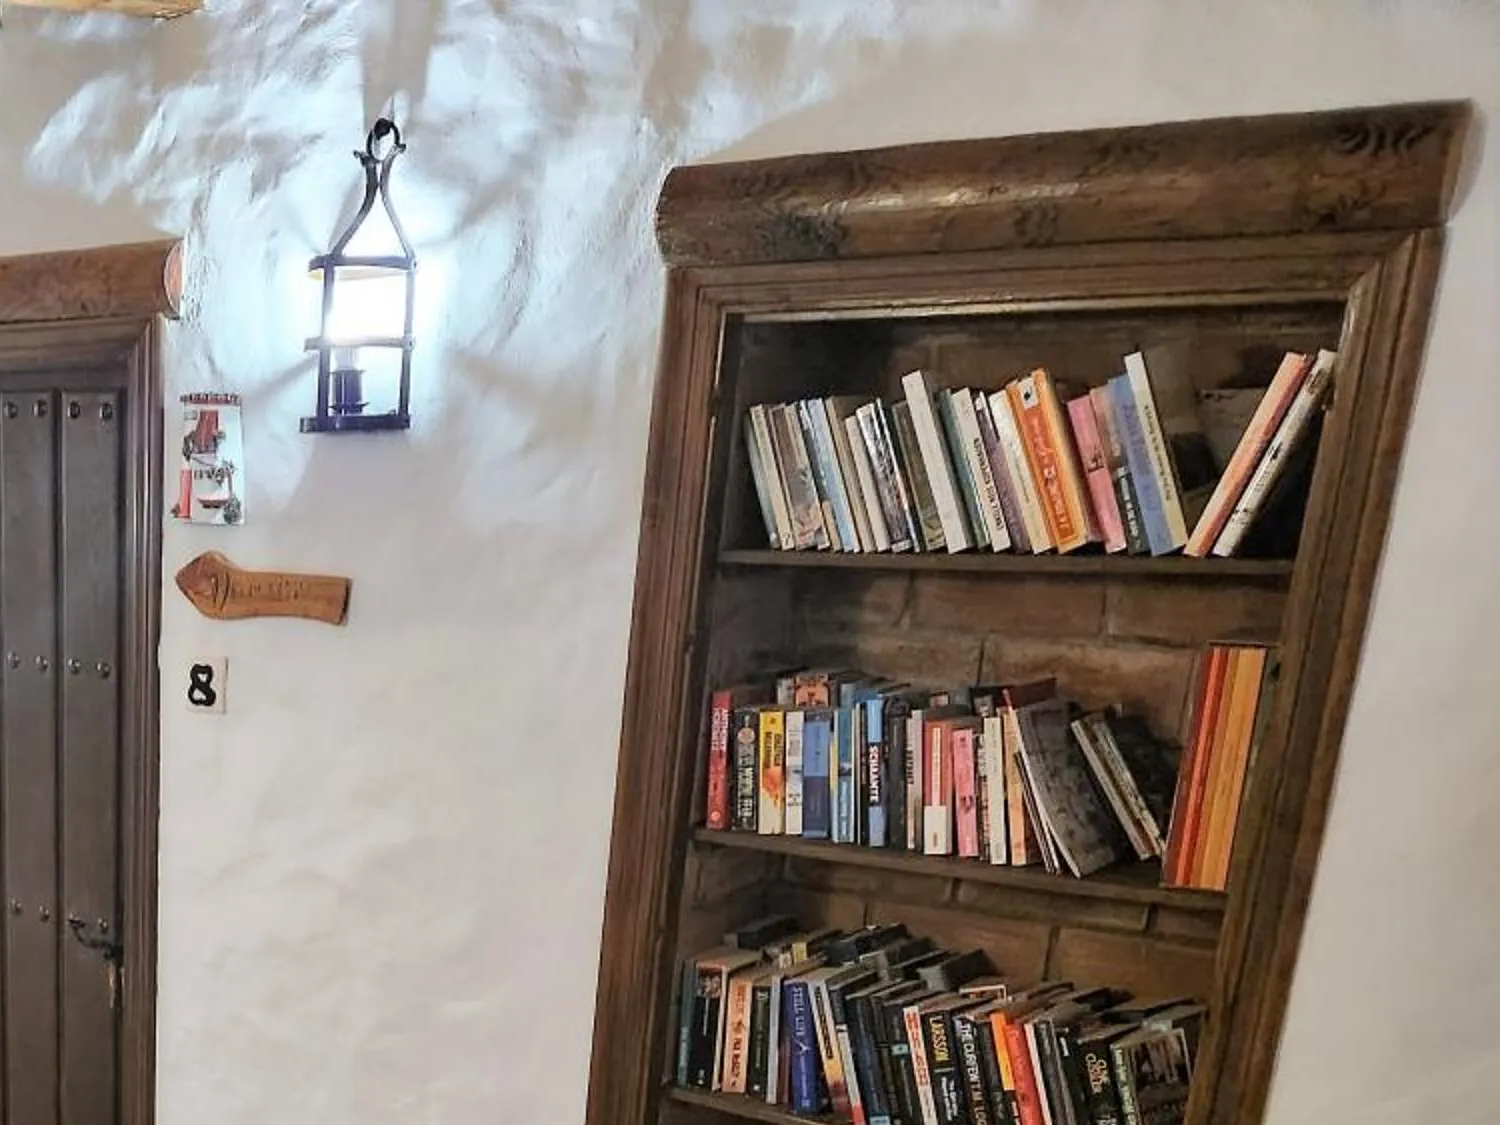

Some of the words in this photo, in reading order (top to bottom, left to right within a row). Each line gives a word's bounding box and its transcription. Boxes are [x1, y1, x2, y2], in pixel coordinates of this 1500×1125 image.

[188, 663, 216, 706] 8
[929, 1015, 950, 1062] LARSSON
[960, 1021, 973, 1042] THE
